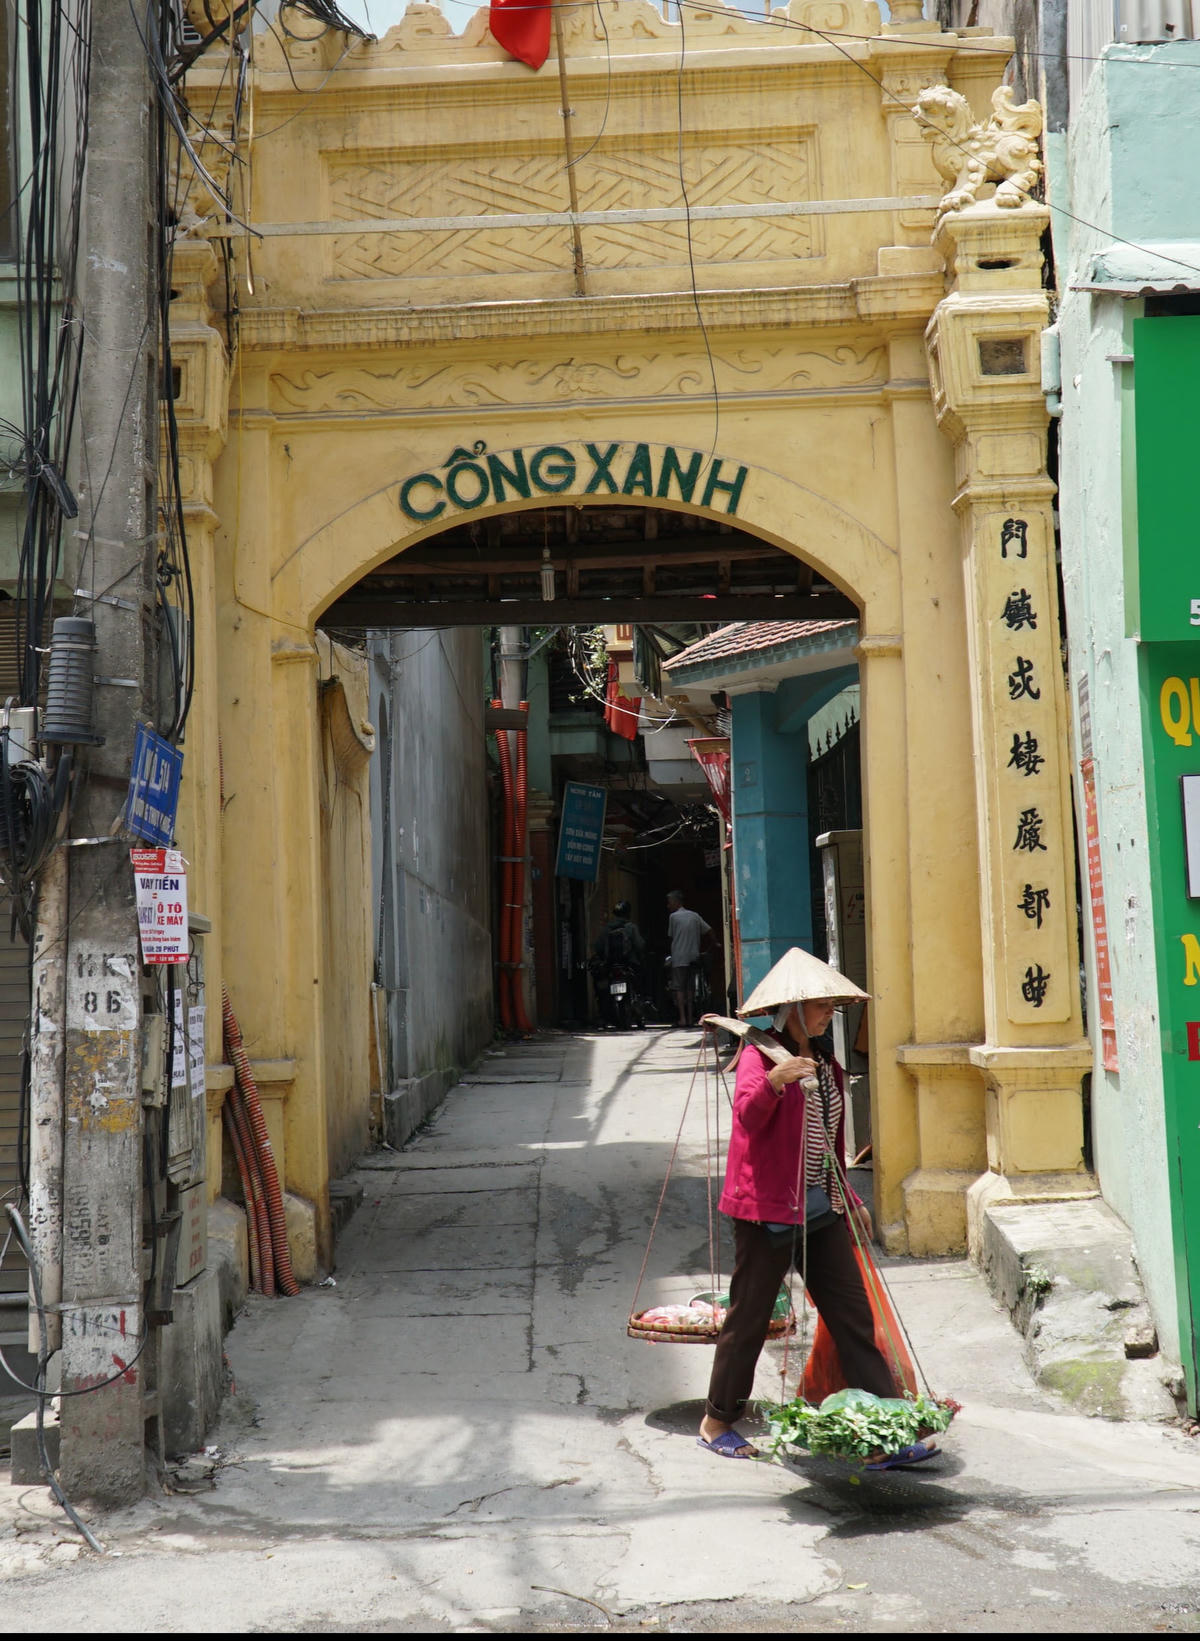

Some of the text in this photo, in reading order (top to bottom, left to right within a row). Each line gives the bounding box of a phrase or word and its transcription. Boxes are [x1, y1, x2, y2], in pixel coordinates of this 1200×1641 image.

[399, 439, 749, 522] CỔNG XANH
[167, 901, 182, 914] TÔ
[157, 915, 184, 926] XE MÁY
